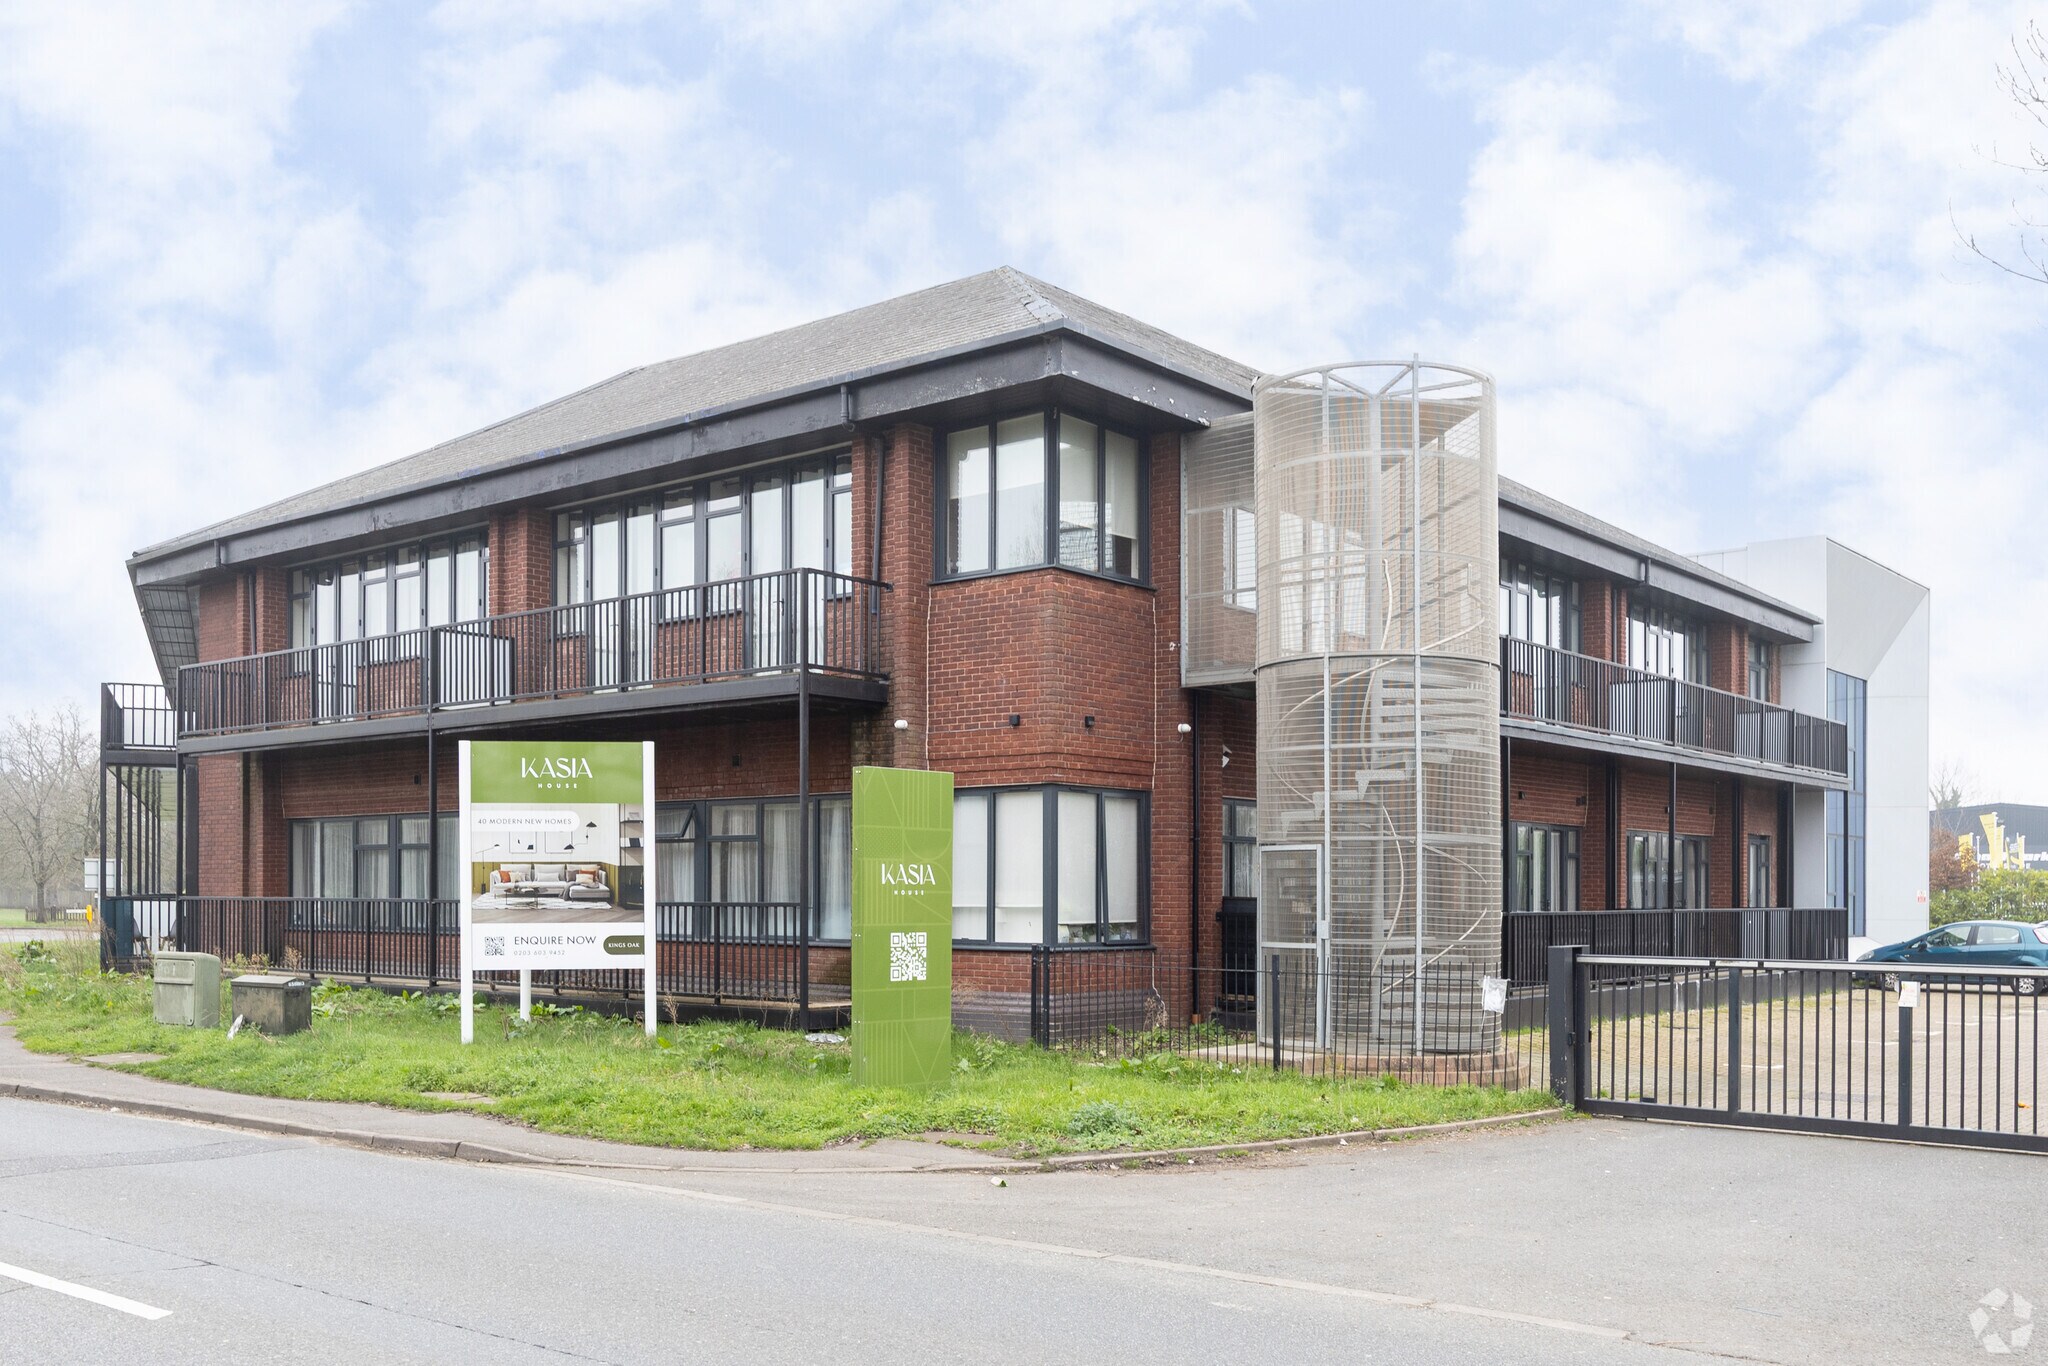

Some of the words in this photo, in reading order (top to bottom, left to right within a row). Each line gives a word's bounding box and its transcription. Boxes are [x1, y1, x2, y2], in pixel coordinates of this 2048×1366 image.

[521, 757, 593, 779] KASIA
[881, 863, 936, 885] KASIA
[514, 936, 564, 945] ENQUIRE
[566, 935, 597, 945] NOW
